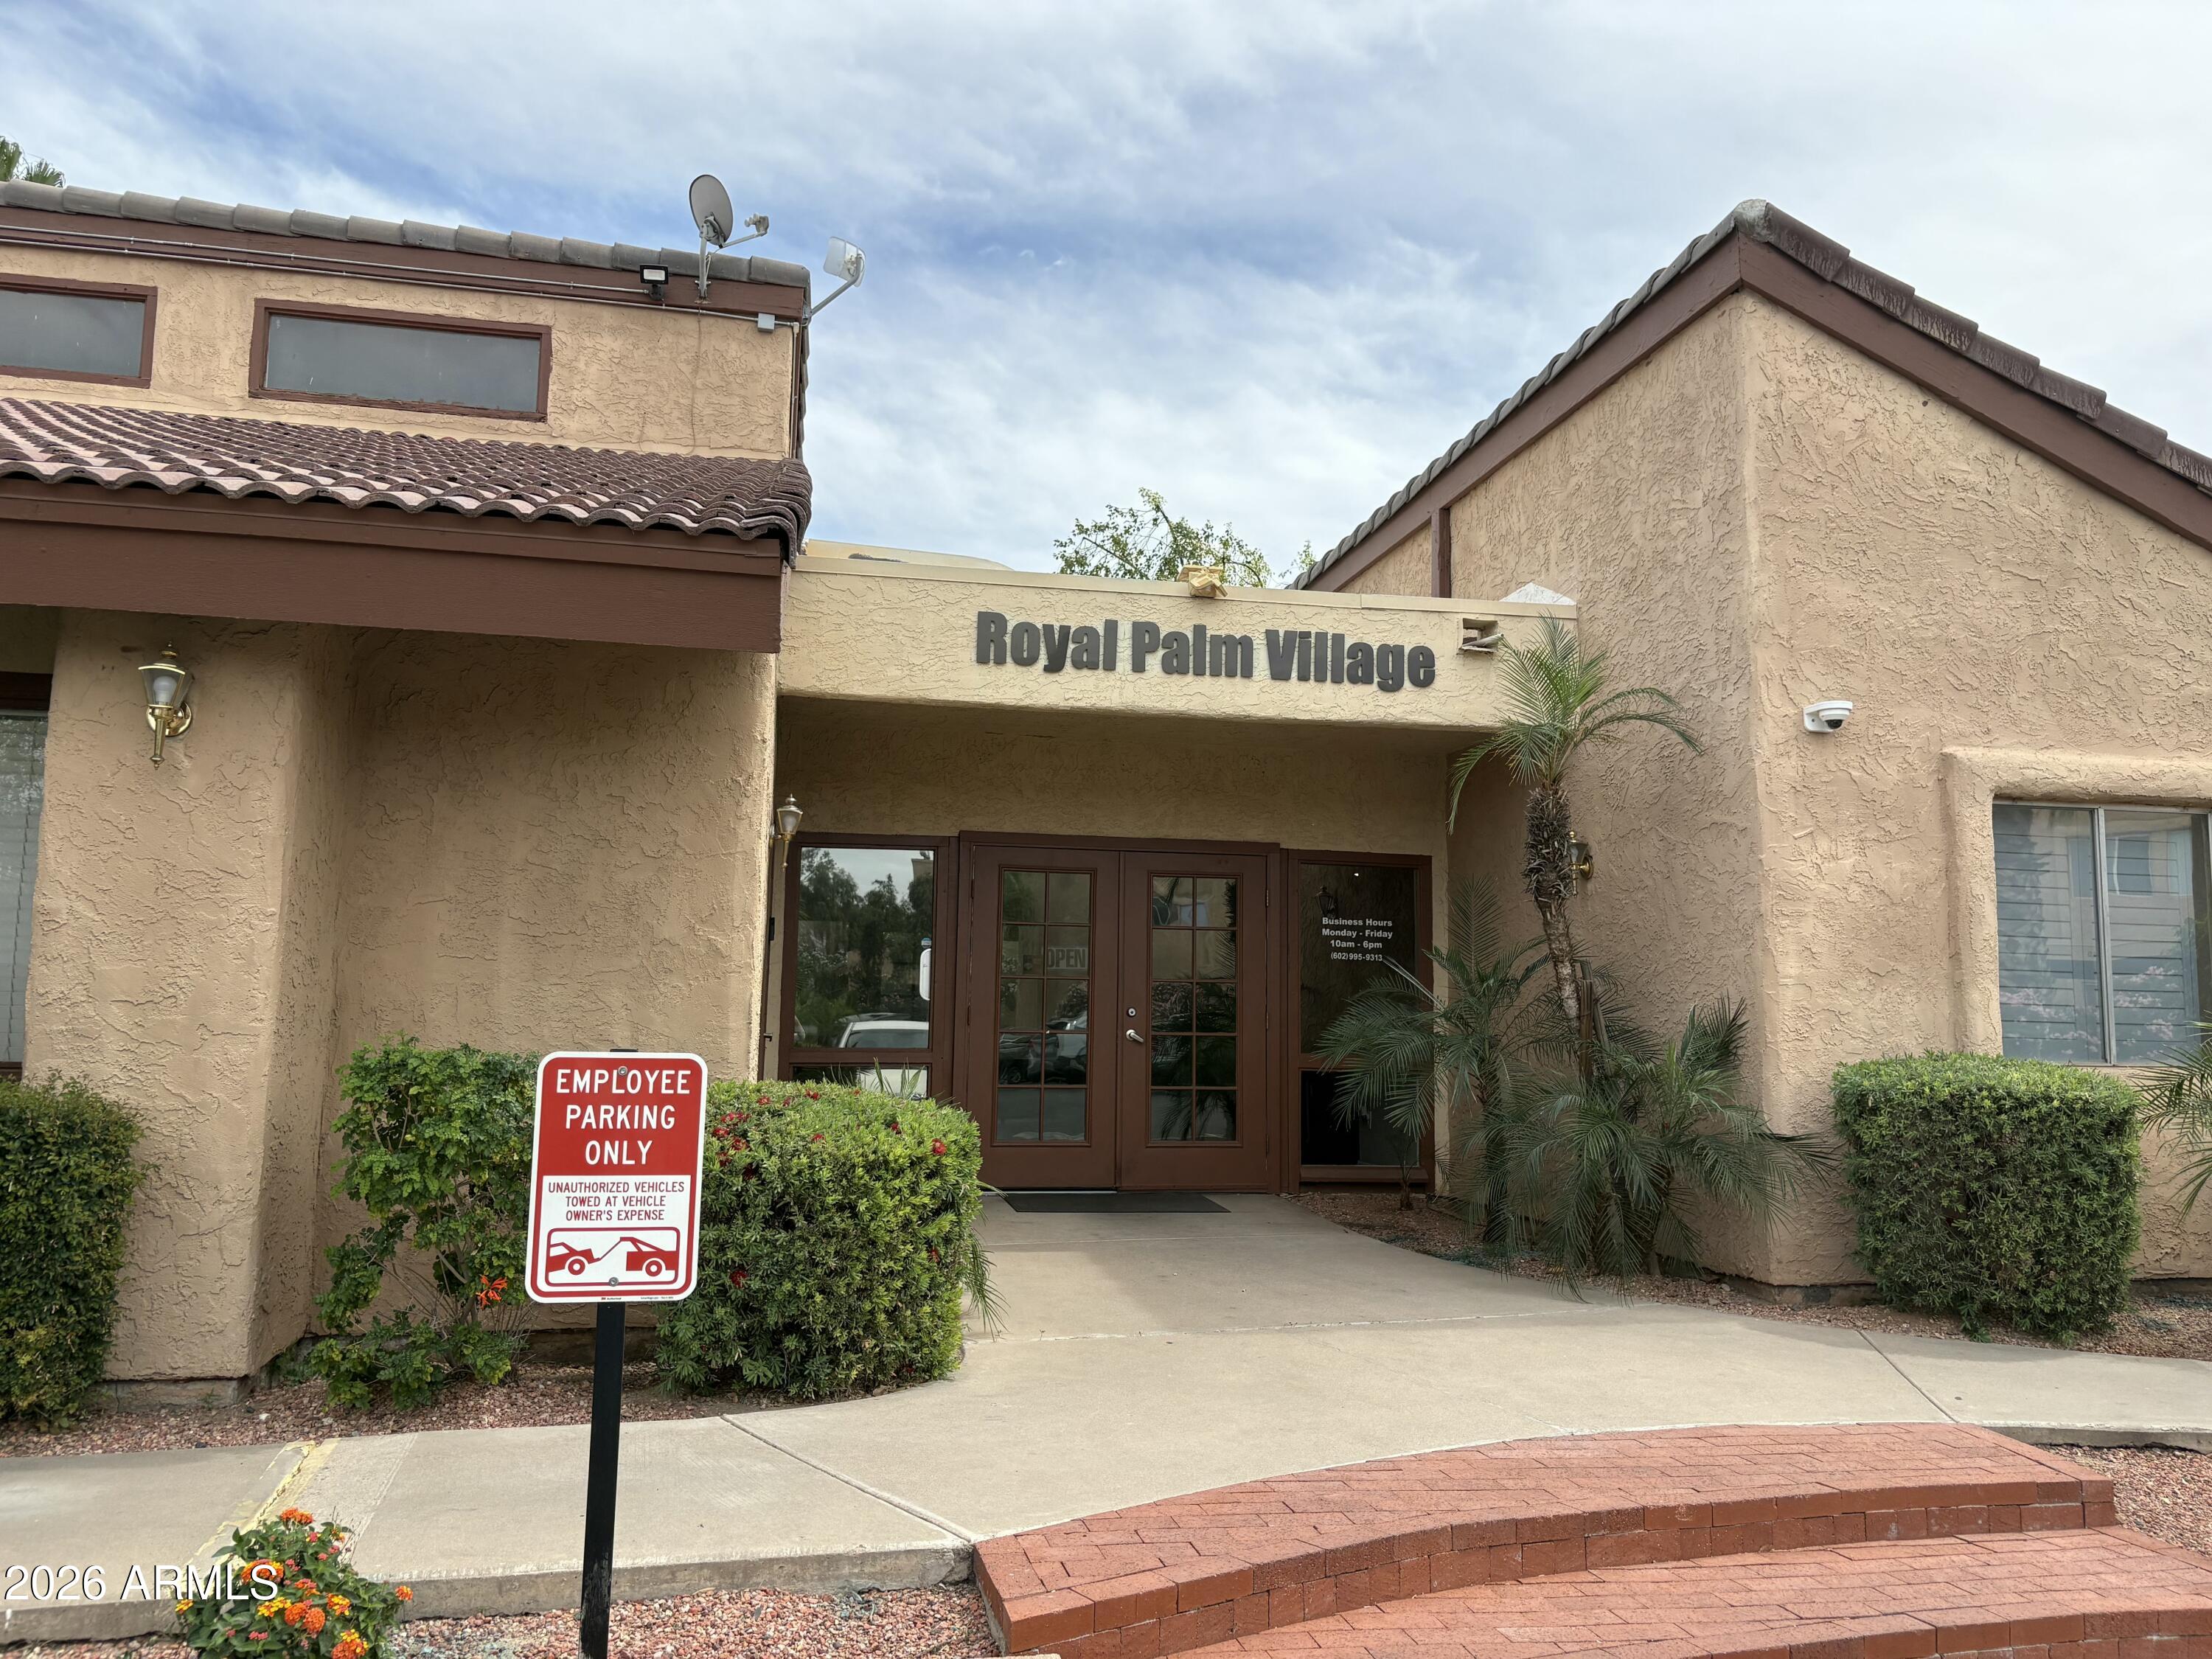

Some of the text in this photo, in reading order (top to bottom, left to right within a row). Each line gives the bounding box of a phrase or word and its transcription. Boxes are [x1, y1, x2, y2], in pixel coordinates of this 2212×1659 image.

[976, 611, 1436, 692] Royal Palm Village
[1322, 917, 1393, 927] Business Hours
[1321, 928, 1357, 939] Monday
[1365, 929, 1393, 939] Friday
[1330, 939, 1355, 947] 10am
[1363, 940, 1382, 950] 6pm
[1046, 948, 1086, 968] OPEN
[557, 1069, 691, 1094] EMPLOYEE
[566, 1105, 675, 1130] PARKING
[585, 1140, 653, 1165] ONLY
[549, 1181, 684, 1193] UNAUTHORIZED VEHICLES
[566, 1195, 667, 1207] TOWED AT VEHICLE
[566, 1209, 665, 1221] OWNER'S EXPENSE
